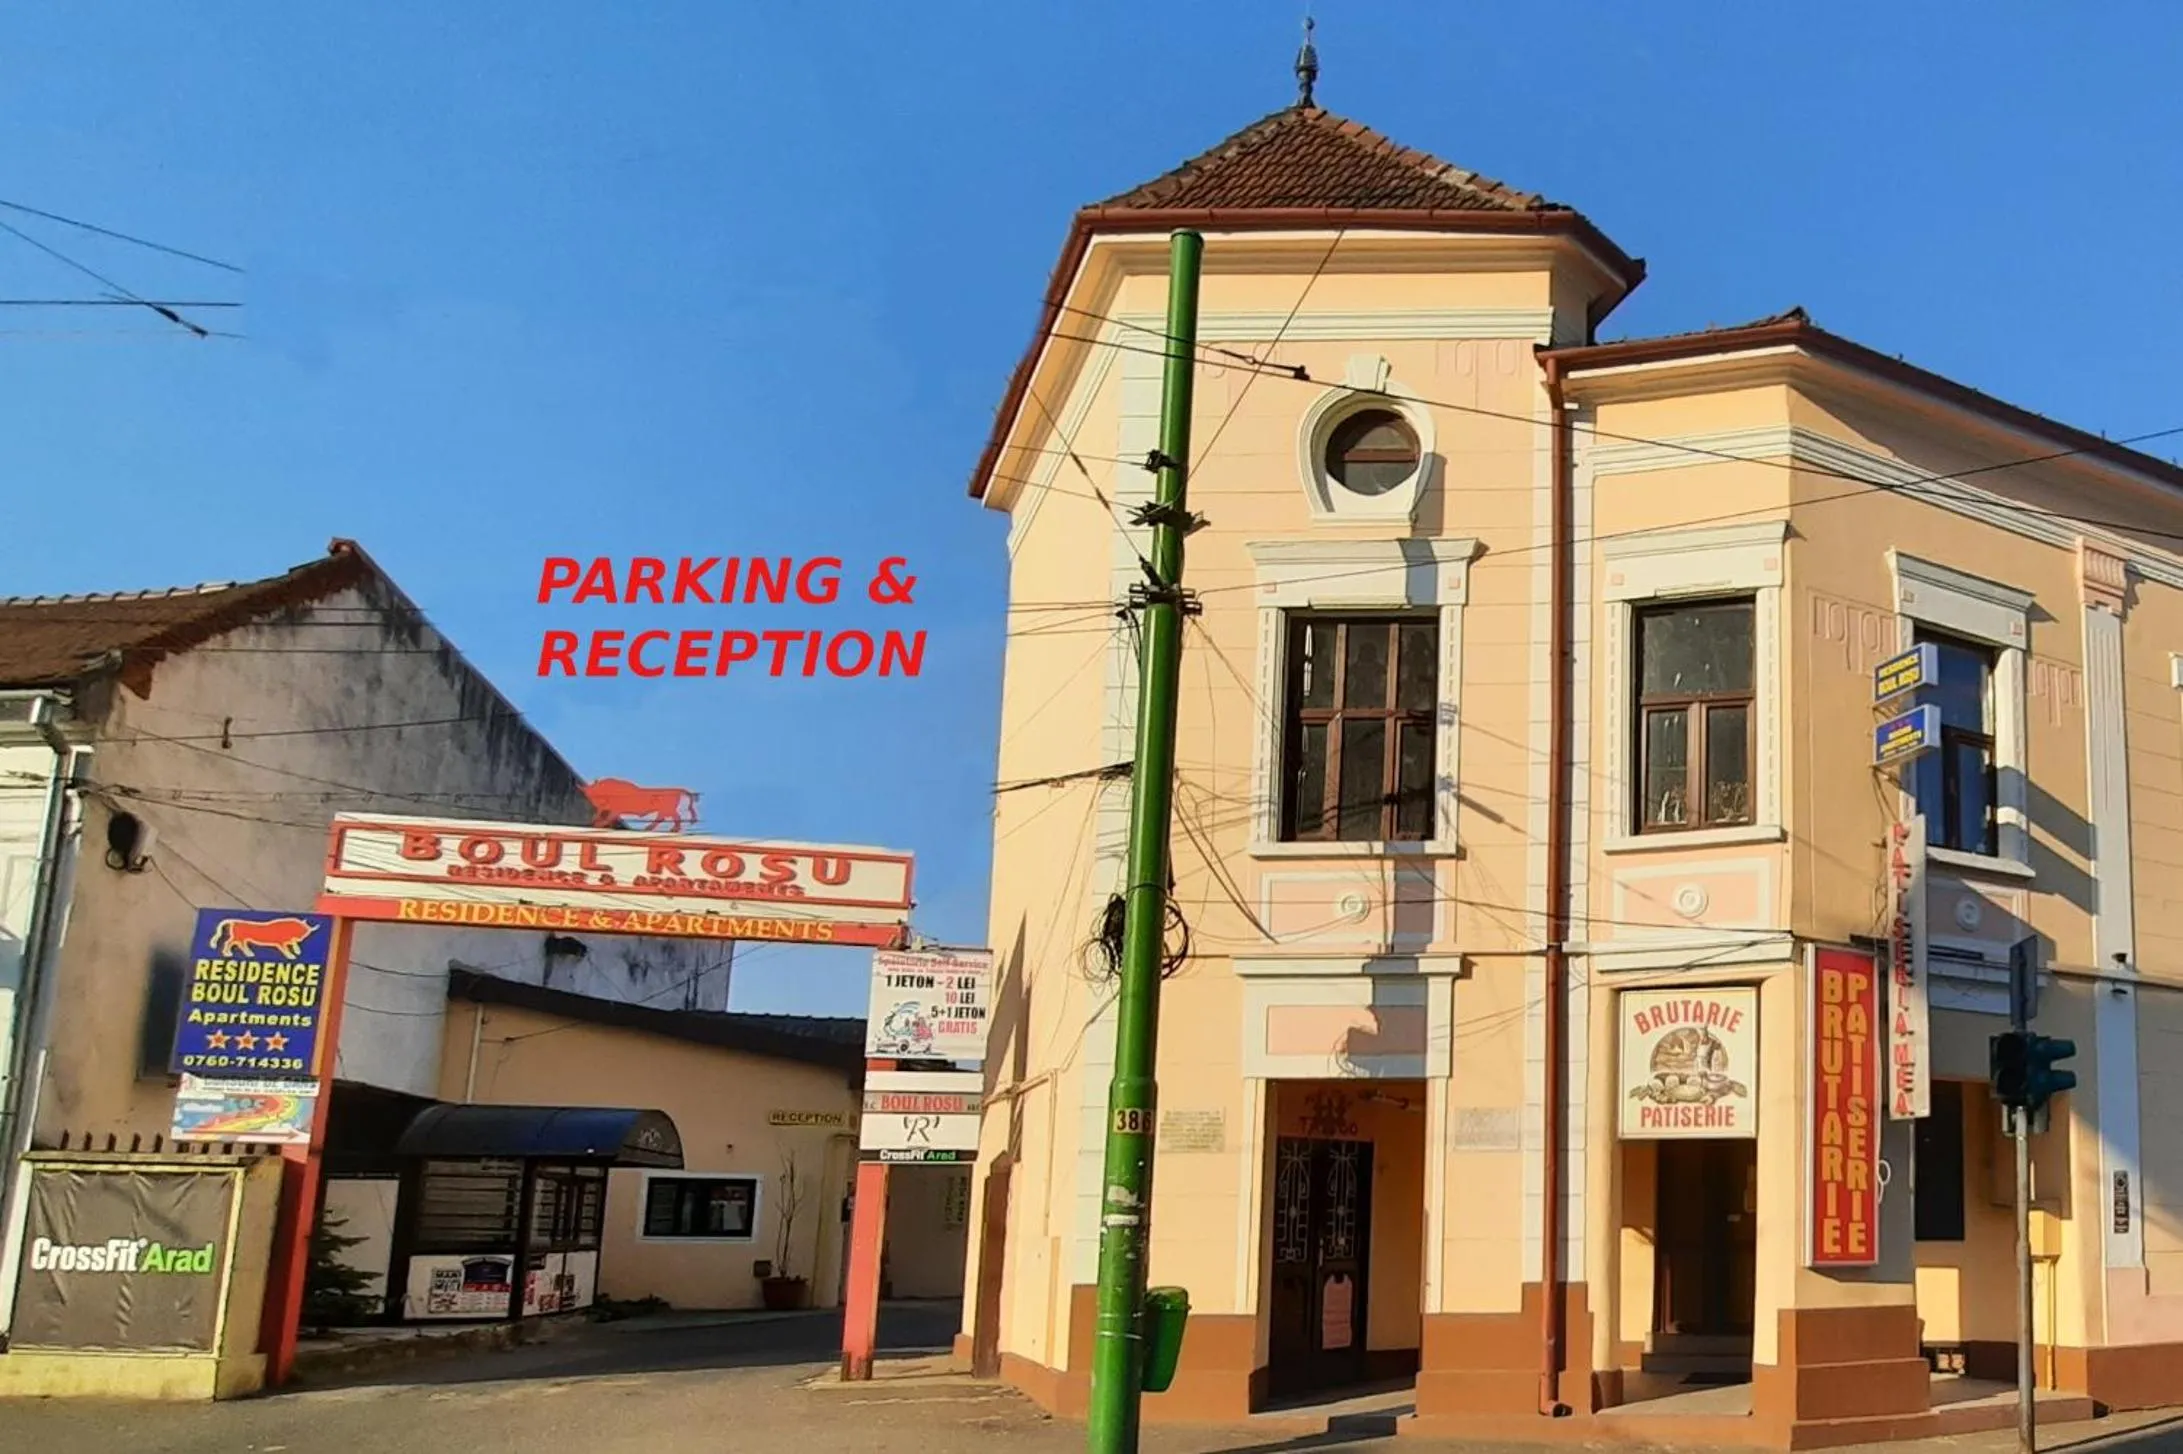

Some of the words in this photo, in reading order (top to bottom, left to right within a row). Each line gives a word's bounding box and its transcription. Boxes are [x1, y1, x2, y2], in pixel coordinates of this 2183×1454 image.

[400, 829, 614, 872] BOUL
[646, 846, 851, 886] ROSU
[399, 899, 581, 929] RESIDENCE
[588, 910, 613, 929] &
[621, 911, 834, 940] APARTMENTS
[195, 959, 321, 986] RESIDENCE
[886, 974, 893, 988] 1
[895, 974, 935, 989] JETON
[945, 976, 955, 990] 2
[957, 977, 976, 990] LEI
[191, 982, 250, 1004] BOUL
[256, 985, 317, 1007] ROSU
[945, 992, 958, 1005] 10
[960, 993, 975, 1005] LEI
[187, 1008, 313, 1028] Apartments
[954, 1006, 986, 1019] JETON
[1633, 999, 1745, 1036] BRUTARIE
[938, 1021, 978, 1034] GRATIS
[182, 1055, 304, 1070] 0760-714336
[881, 1095, 920, 1111] BOUL
[923, 1095, 964, 1112] ROSU
[1821, 969, 1844, 1255] BRUTARIE
[1847, 972, 1869, 1255] PATISERIE
[771, 1111, 842, 1124] RECEPTION
[1640, 1105, 1736, 1129] PATISERIE
[139, 1242, 215, 1273] Arad
